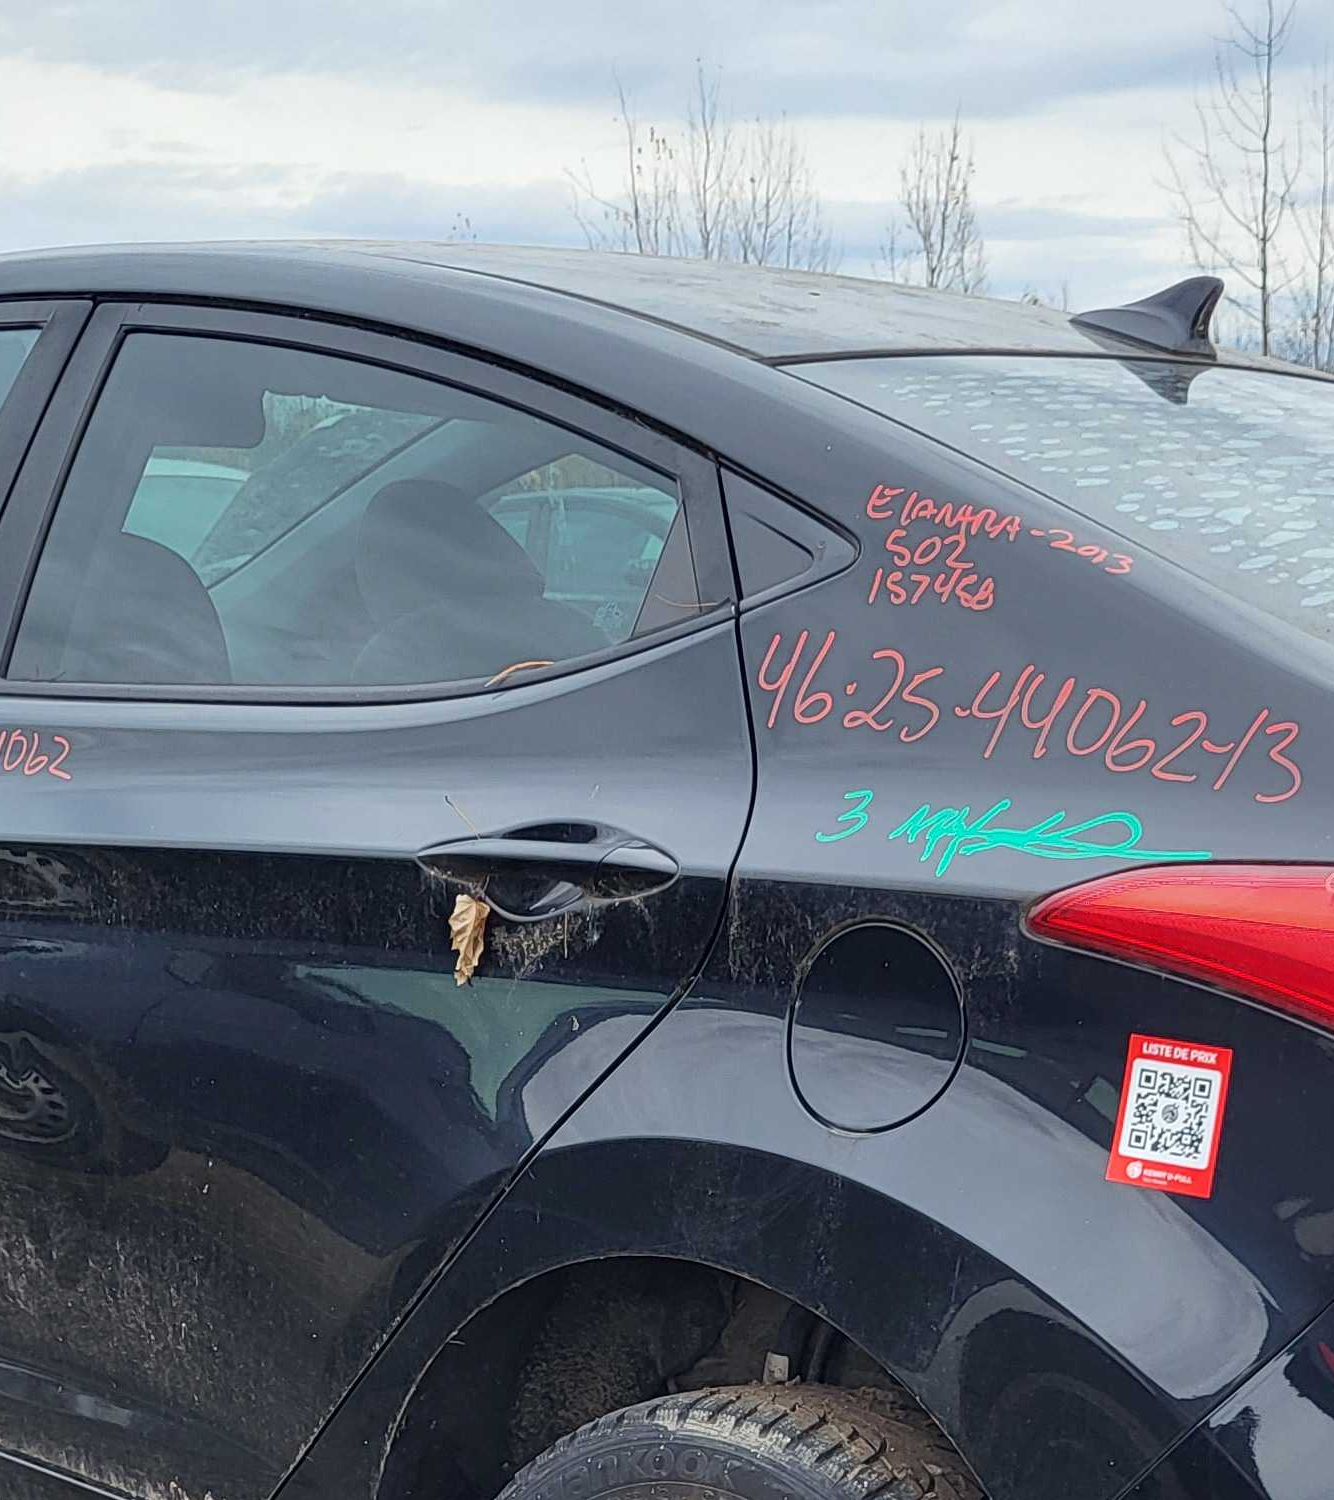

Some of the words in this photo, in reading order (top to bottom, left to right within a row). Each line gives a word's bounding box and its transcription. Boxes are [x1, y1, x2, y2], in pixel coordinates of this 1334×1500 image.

[815, 789, 874, 843] 3
[1142, 1041, 1173, 1058] LISTE
[1173, 1047, 1190, 1060] DE
[1190, 1049, 1218, 1065] PRIX
